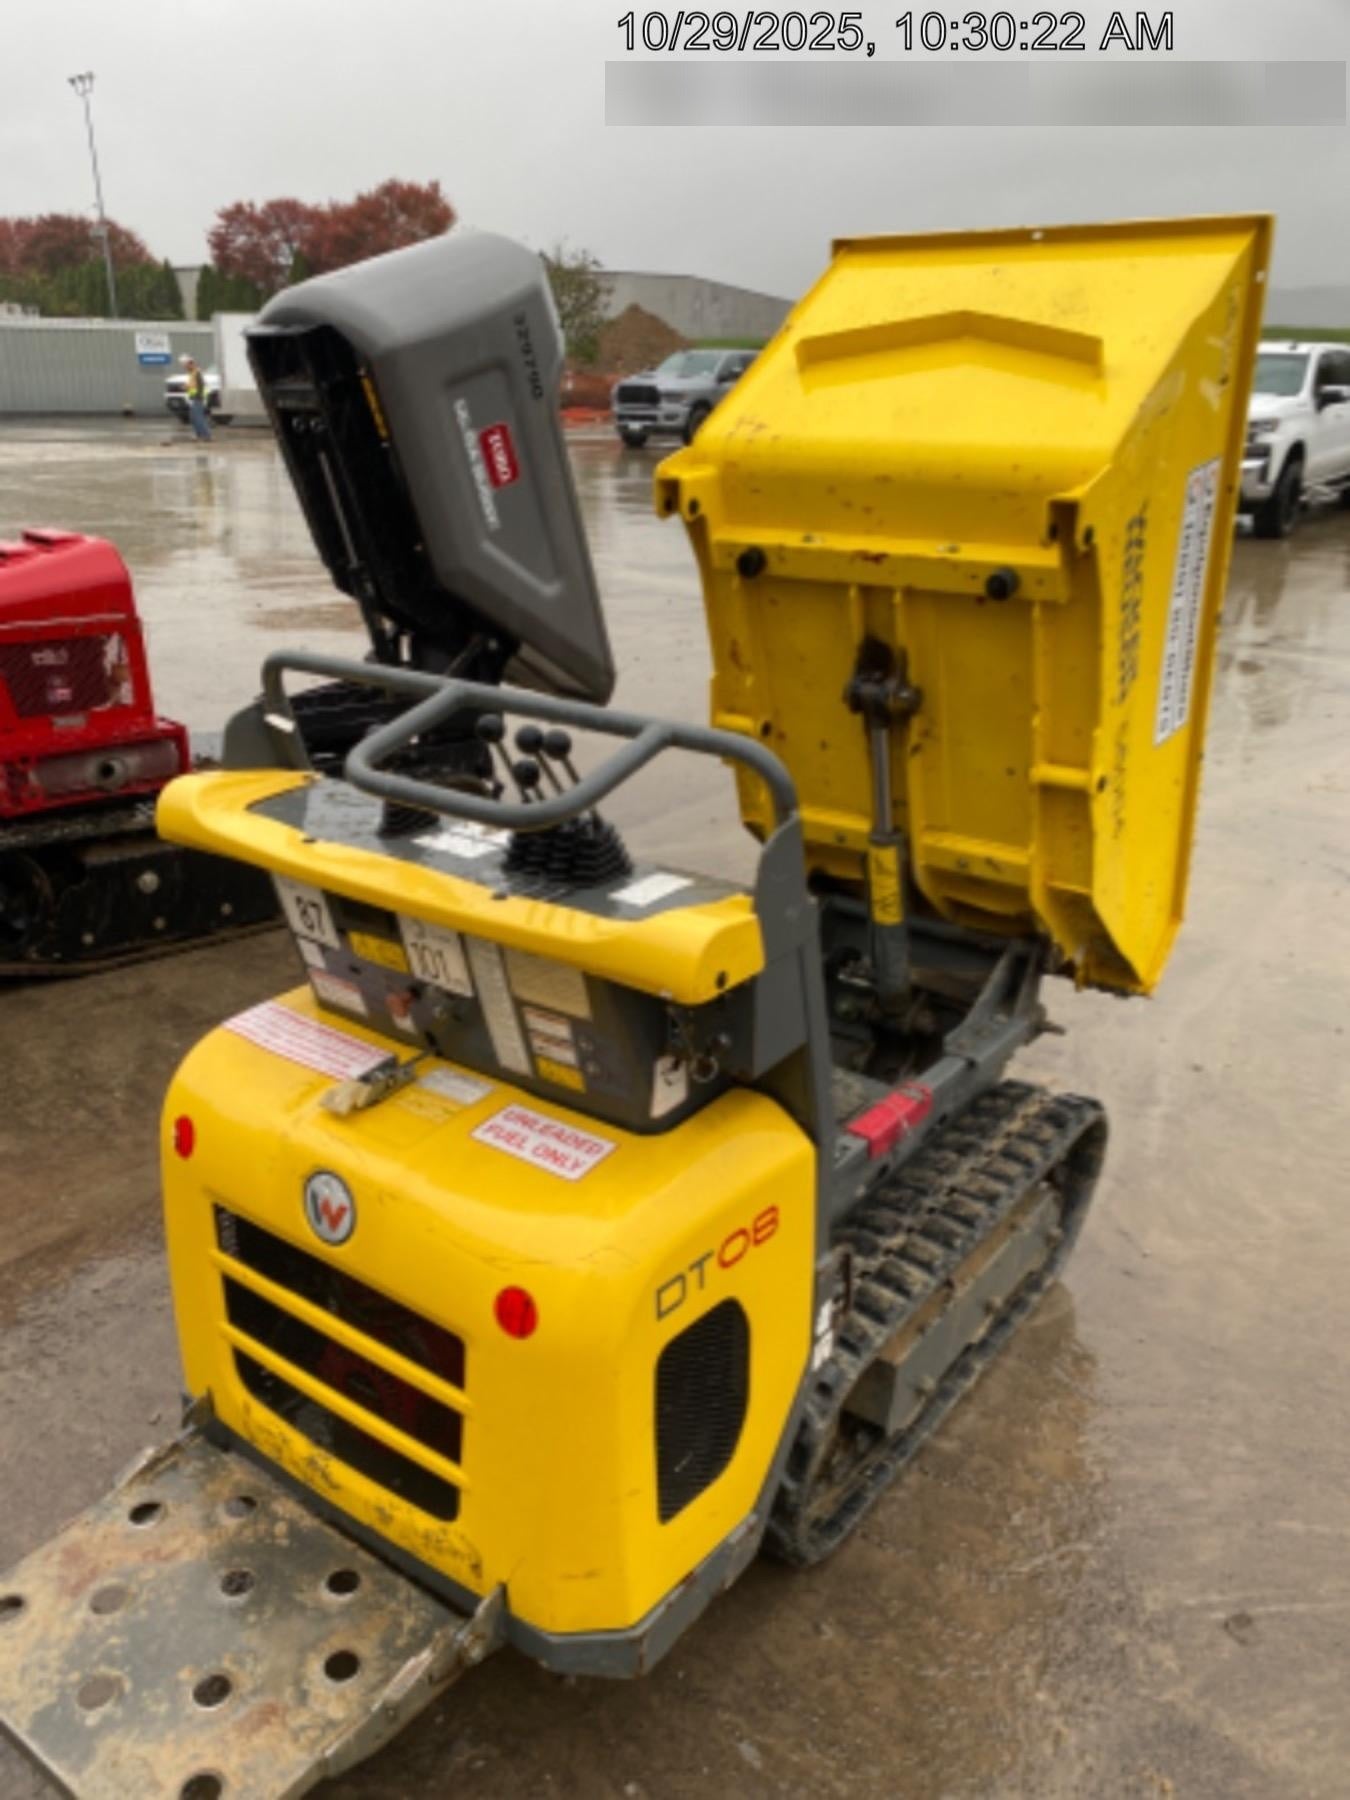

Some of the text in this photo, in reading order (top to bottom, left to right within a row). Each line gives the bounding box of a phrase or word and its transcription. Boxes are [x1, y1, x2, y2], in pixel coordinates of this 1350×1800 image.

[482, 1122, 588, 1173] FUEL ONLY
[502, 1109, 605, 1156] UNLEADED
